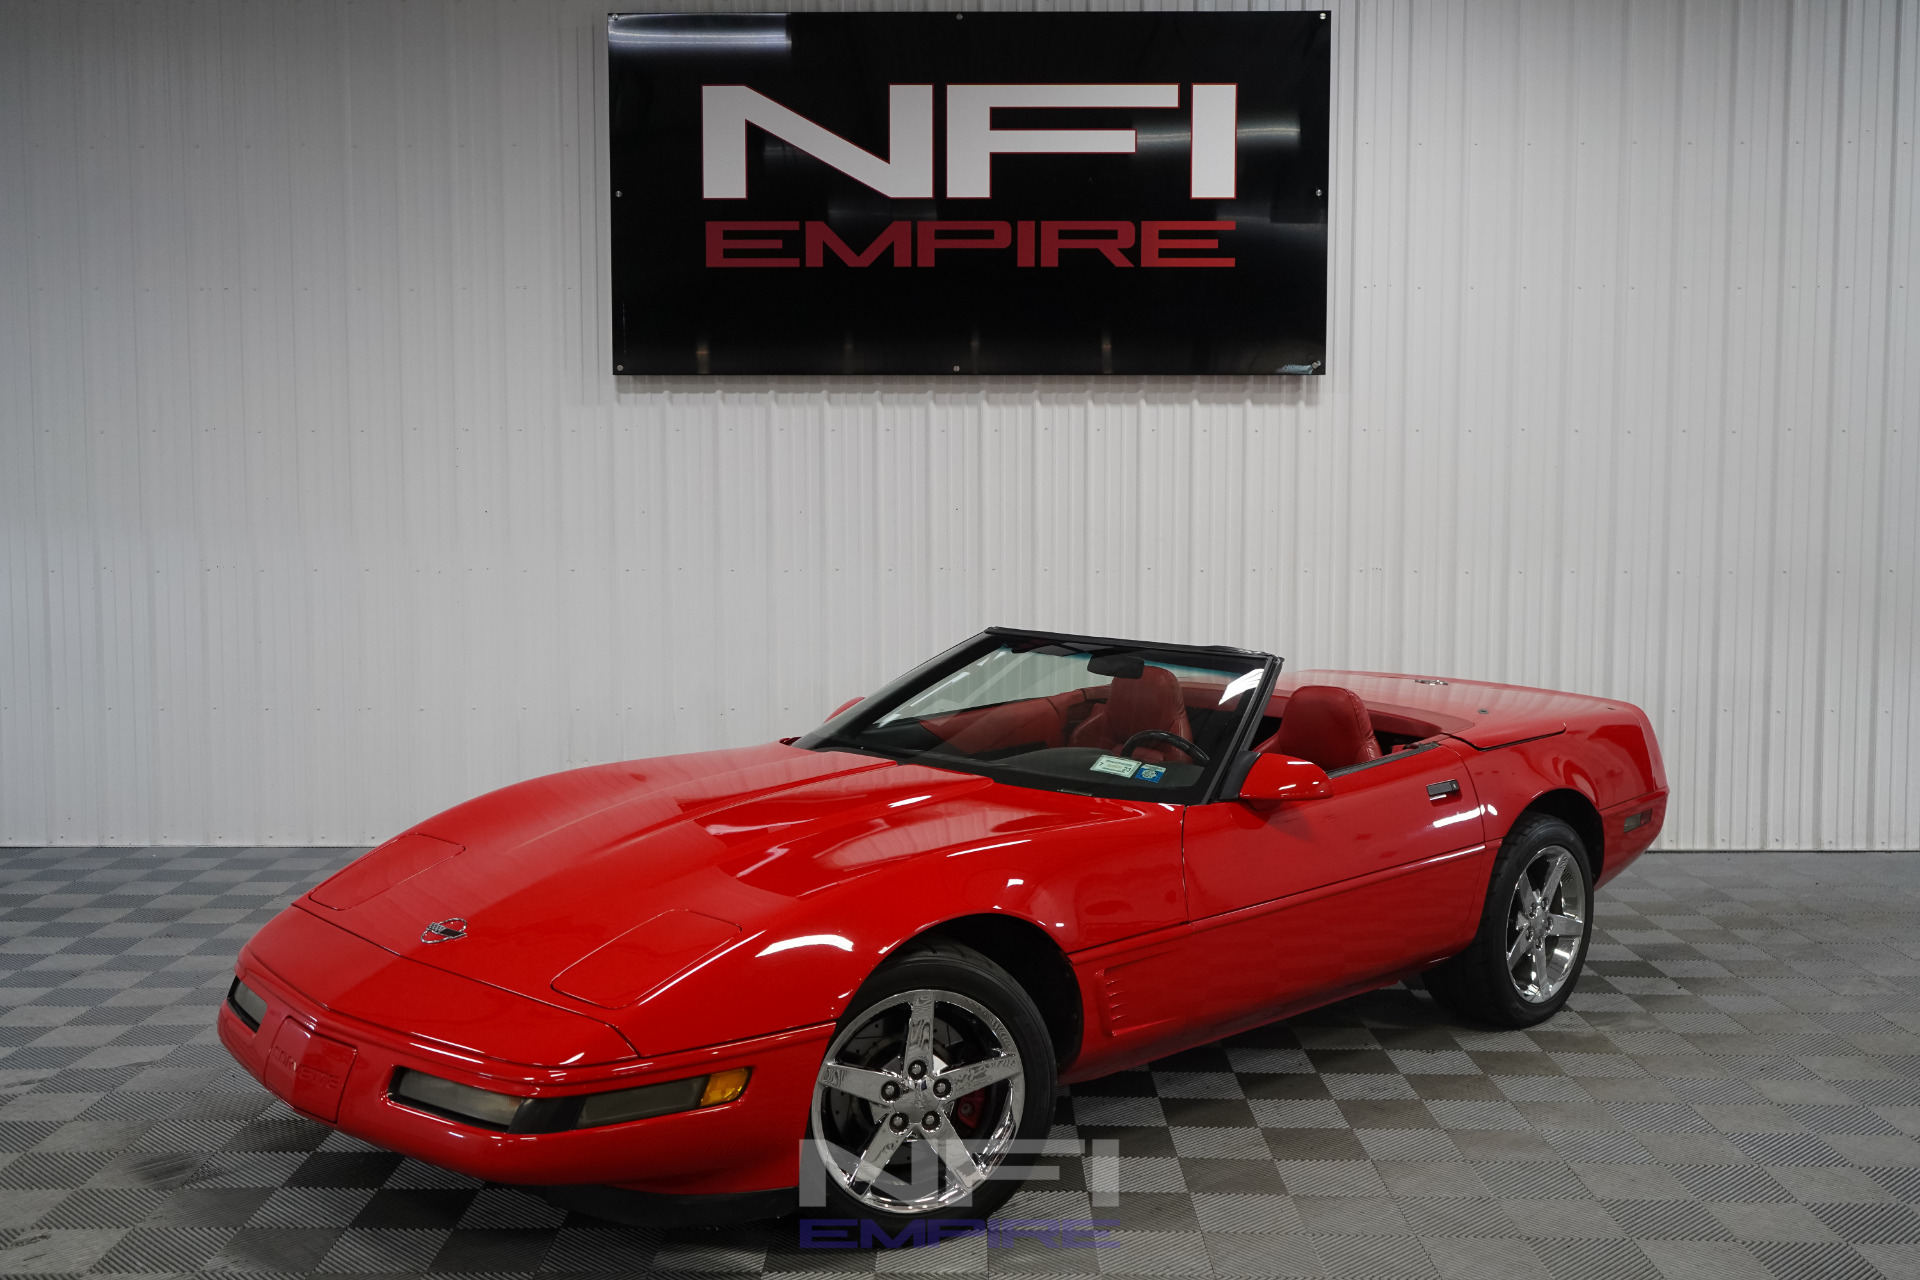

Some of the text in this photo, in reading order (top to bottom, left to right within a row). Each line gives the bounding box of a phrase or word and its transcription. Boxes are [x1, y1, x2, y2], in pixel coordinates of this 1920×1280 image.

[702, 83, 1237, 199] NFI
[705, 220, 1236, 268] EMPIRE
[273, 1046, 341, 1089] CORVETTE
